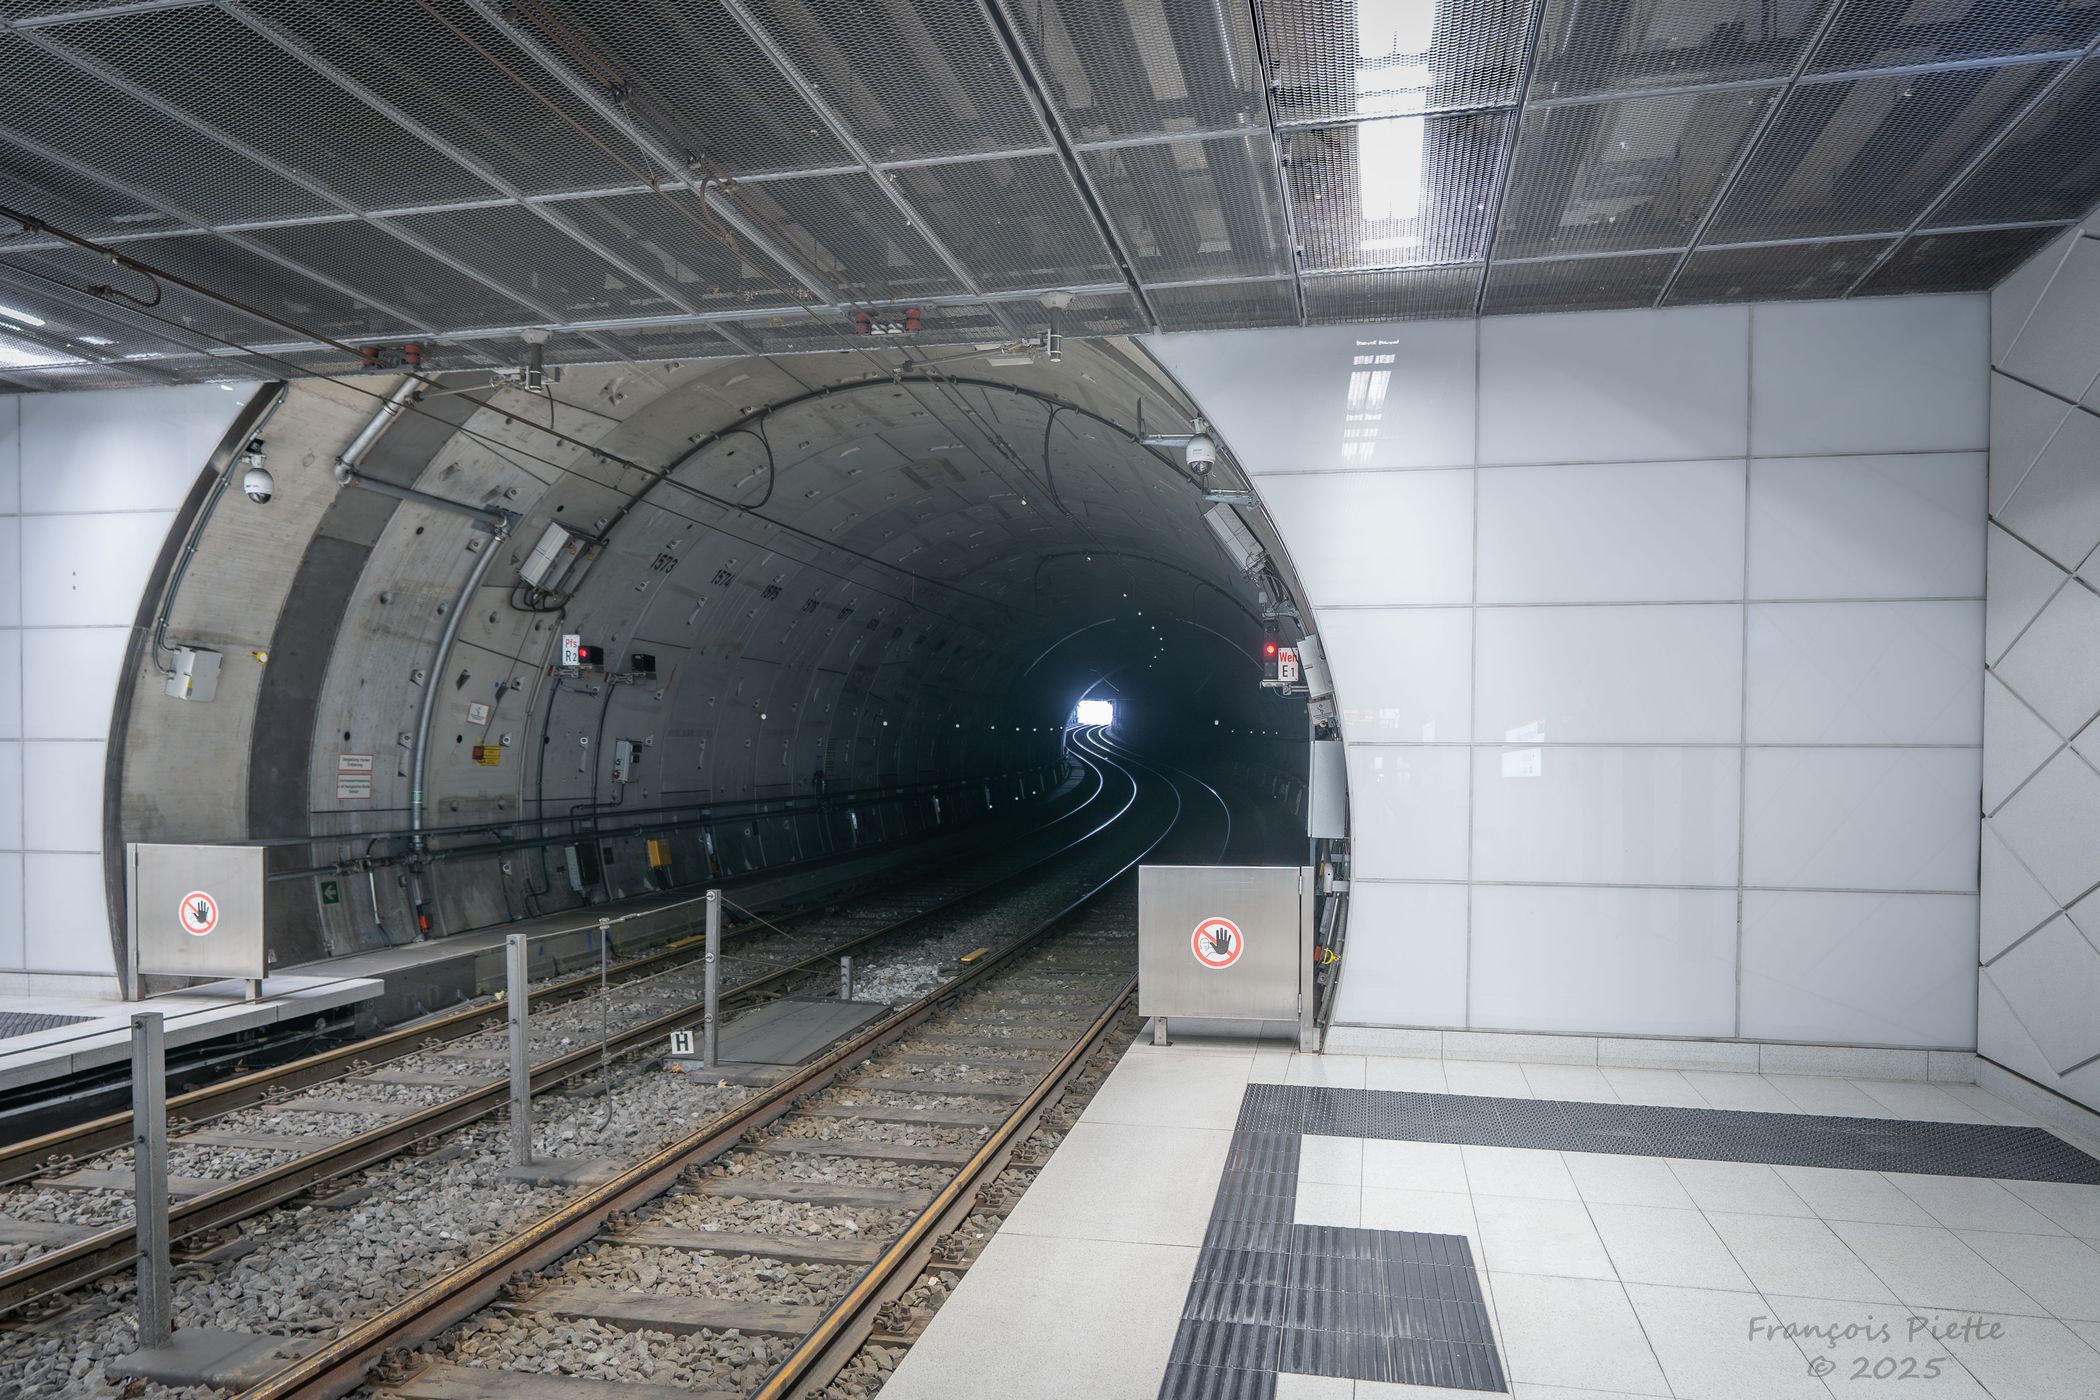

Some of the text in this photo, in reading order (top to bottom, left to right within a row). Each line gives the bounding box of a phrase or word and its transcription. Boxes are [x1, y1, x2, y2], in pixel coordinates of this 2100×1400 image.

[650, 552, 679, 574] 1573
[565, 638, 577, 648] Pfs
[675, 1033, 689, 1051] H
